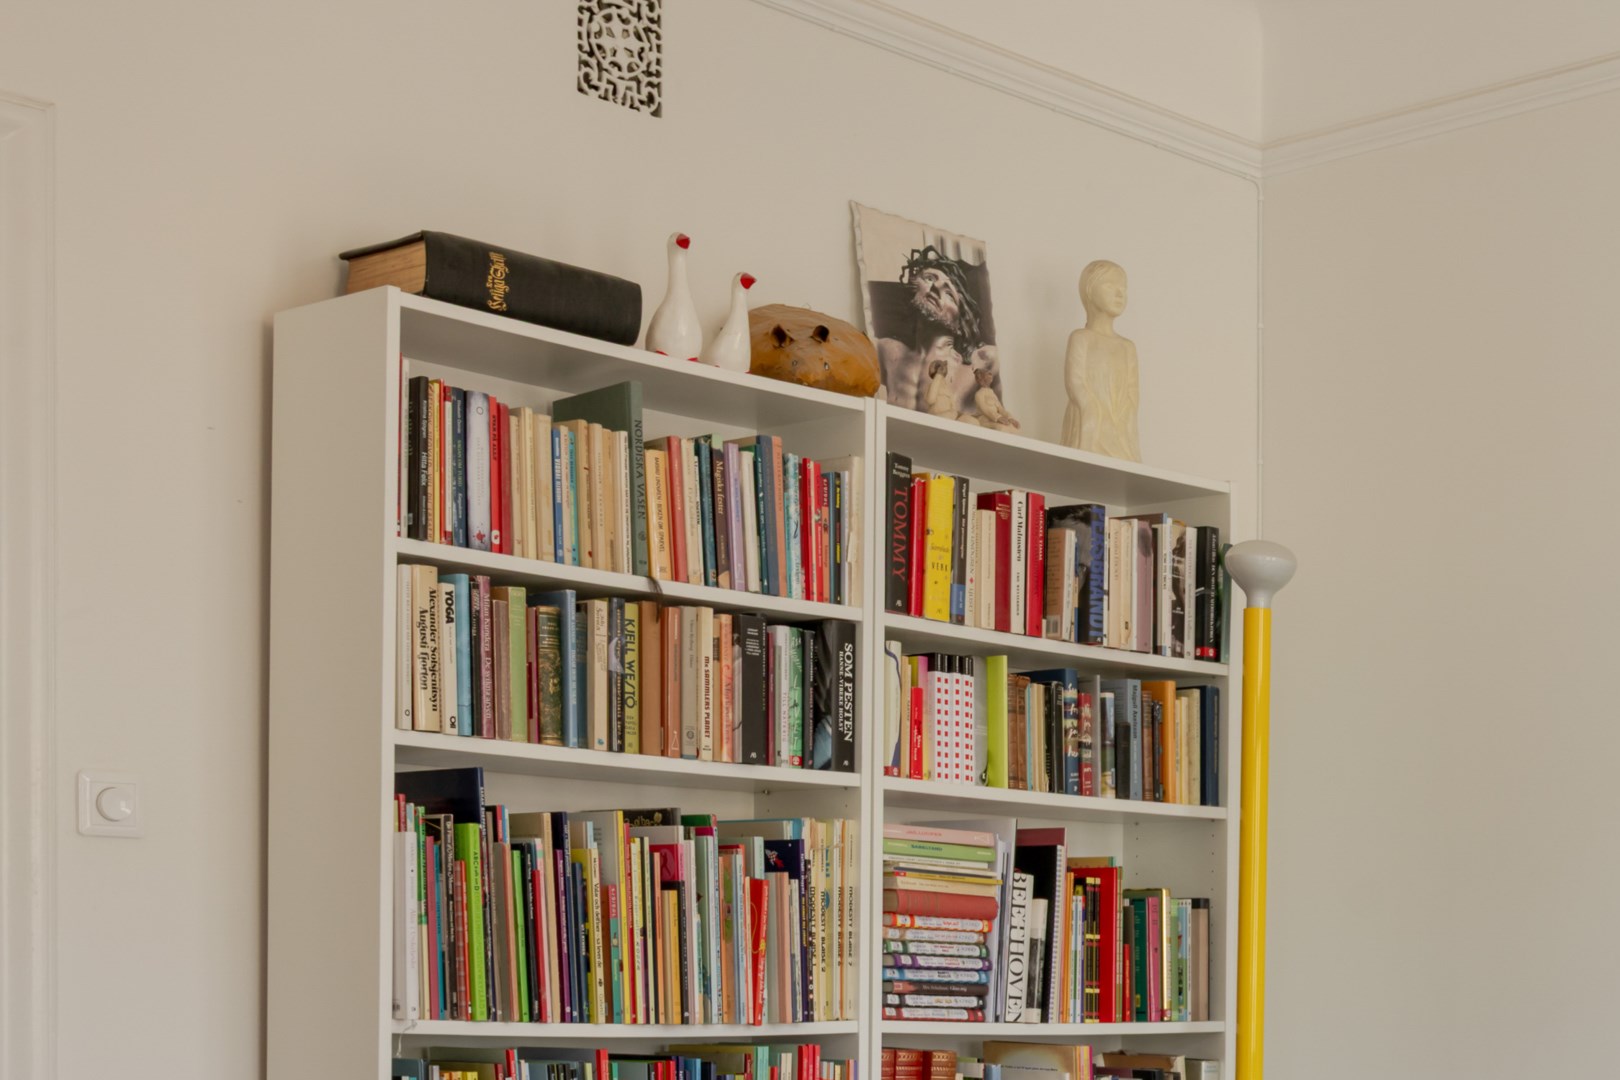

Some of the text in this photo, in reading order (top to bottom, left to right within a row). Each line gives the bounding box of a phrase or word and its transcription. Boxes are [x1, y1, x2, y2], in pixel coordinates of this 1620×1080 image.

[488, 251, 509, 280] Skrift
[487, 280, 510, 311] Heliga
[634, 419, 644, 479] NORDISKA
[714, 461, 725, 515] Magiska fester
[892, 486, 908, 583] TOMMY
[1089, 507, 1103, 638] PERSBRANDT
[445, 590, 455, 624] YOGA
[416, 607, 429, 690] Augusti fjorton
[428, 587, 439, 711] Alexander Solsjenitsyn
[624, 619, 636, 655] KJELL
[624, 660, 637, 708] WESTÖ
[844, 643, 853, 742] SOM PESTEN
